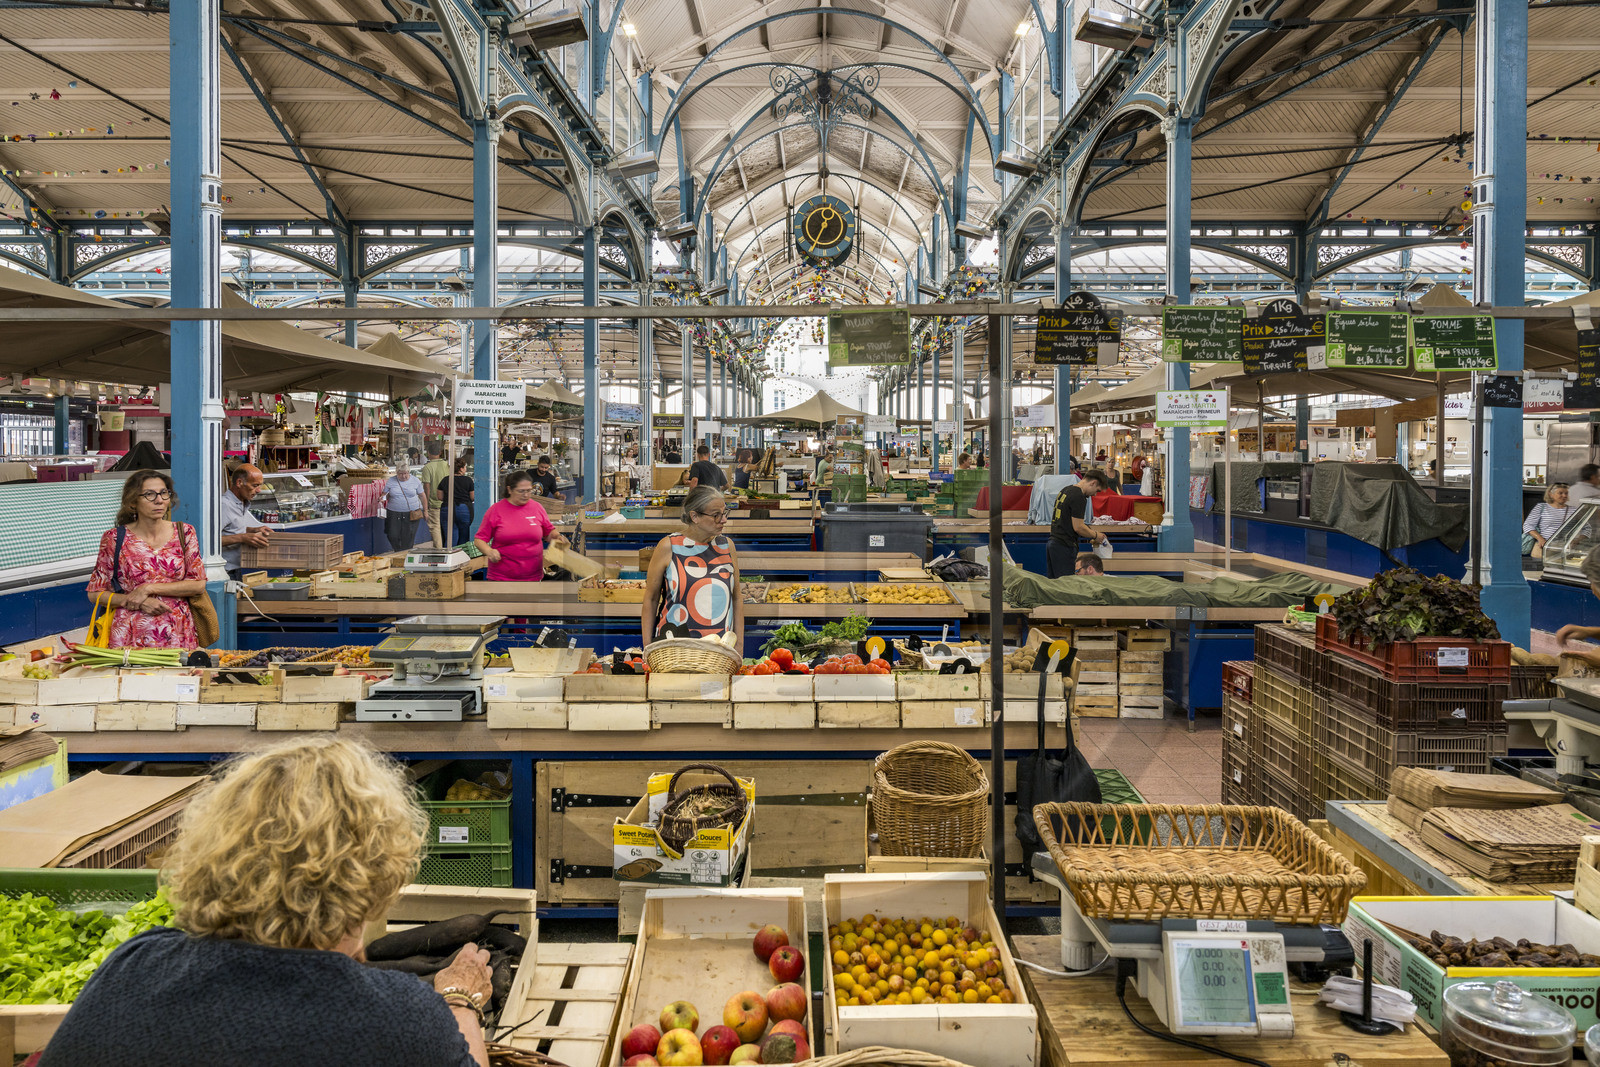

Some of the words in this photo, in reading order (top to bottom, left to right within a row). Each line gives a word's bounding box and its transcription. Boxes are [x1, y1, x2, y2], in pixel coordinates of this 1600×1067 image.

[1272, 300, 1292, 313] 1Kg
[1038, 316, 1060, 327] Prix
[1108, 317, 1120, 330] €
[1430, 320, 1462, 330] POMME
[1242, 324, 1264, 336] Prix
[1312, 321, 1324, 334] €
[1165, 344, 1180, 354] AB
[1329, 348, 1342, 359] AB
[1233, 351, 1240, 360] €
[1396, 356, 1404, 365] €
[1418, 353, 1431, 363] AB
[631, 848, 635, 856] 6
